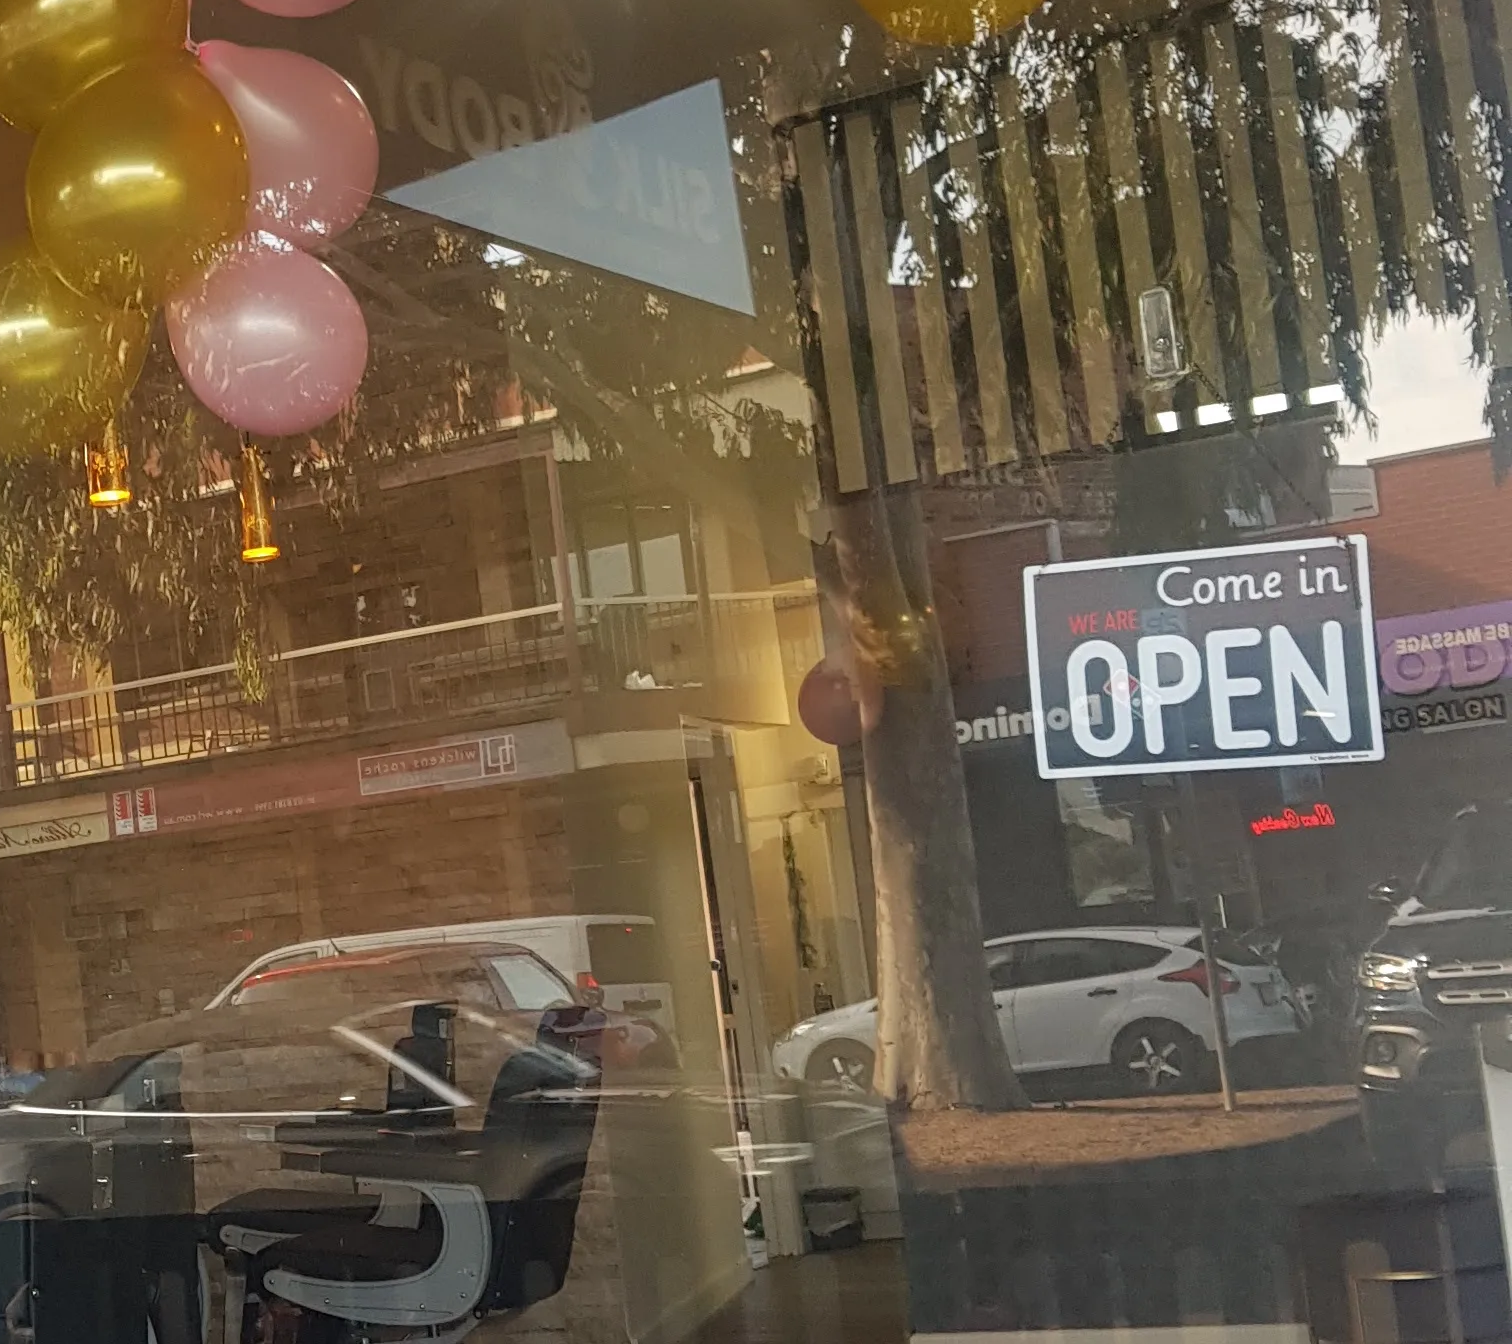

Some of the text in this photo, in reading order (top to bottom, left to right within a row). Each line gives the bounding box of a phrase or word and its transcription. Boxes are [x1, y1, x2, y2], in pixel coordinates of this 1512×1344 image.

[1156, 554, 1349, 606] Come in
[1068, 613, 1098, 635] WE
[1104, 609, 1139, 632] ARE
[1066, 620, 1351, 757] OPEN
[1418, 697, 1502, 726] SALON
